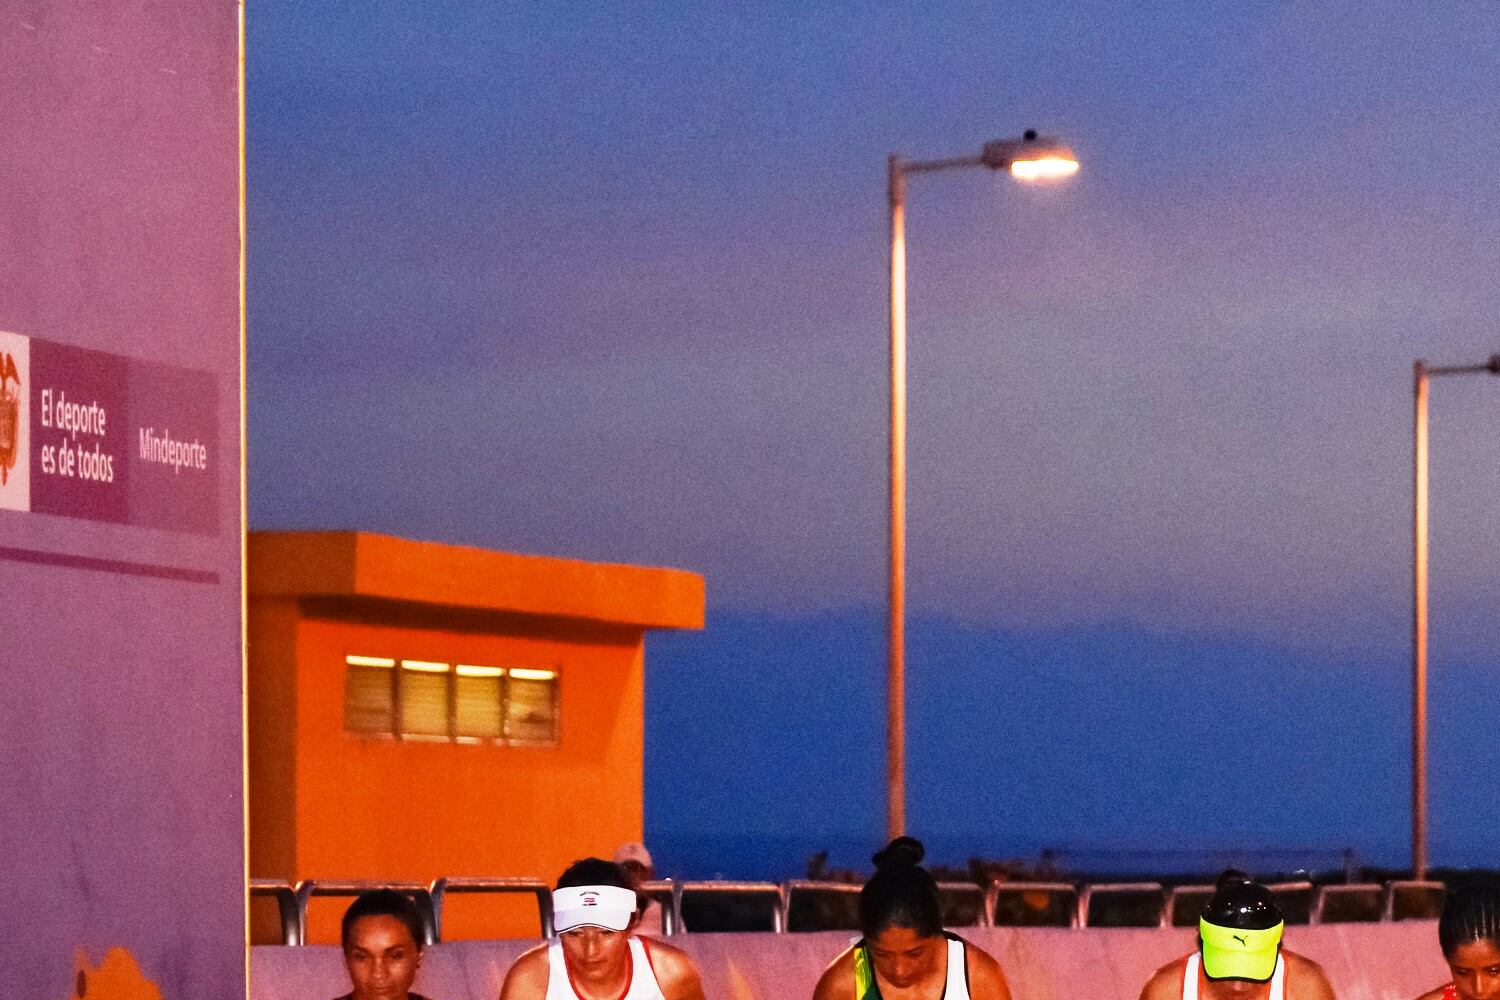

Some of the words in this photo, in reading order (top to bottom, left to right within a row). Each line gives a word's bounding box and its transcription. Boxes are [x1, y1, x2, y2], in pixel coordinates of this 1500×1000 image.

[41, 388, 53, 427] El
[56, 391, 106, 441] deporte
[41, 444, 56, 474] es
[59, 438, 75, 478] de
[77, 443, 114, 483] todos
[139, 427, 207, 475] Mindeporte
